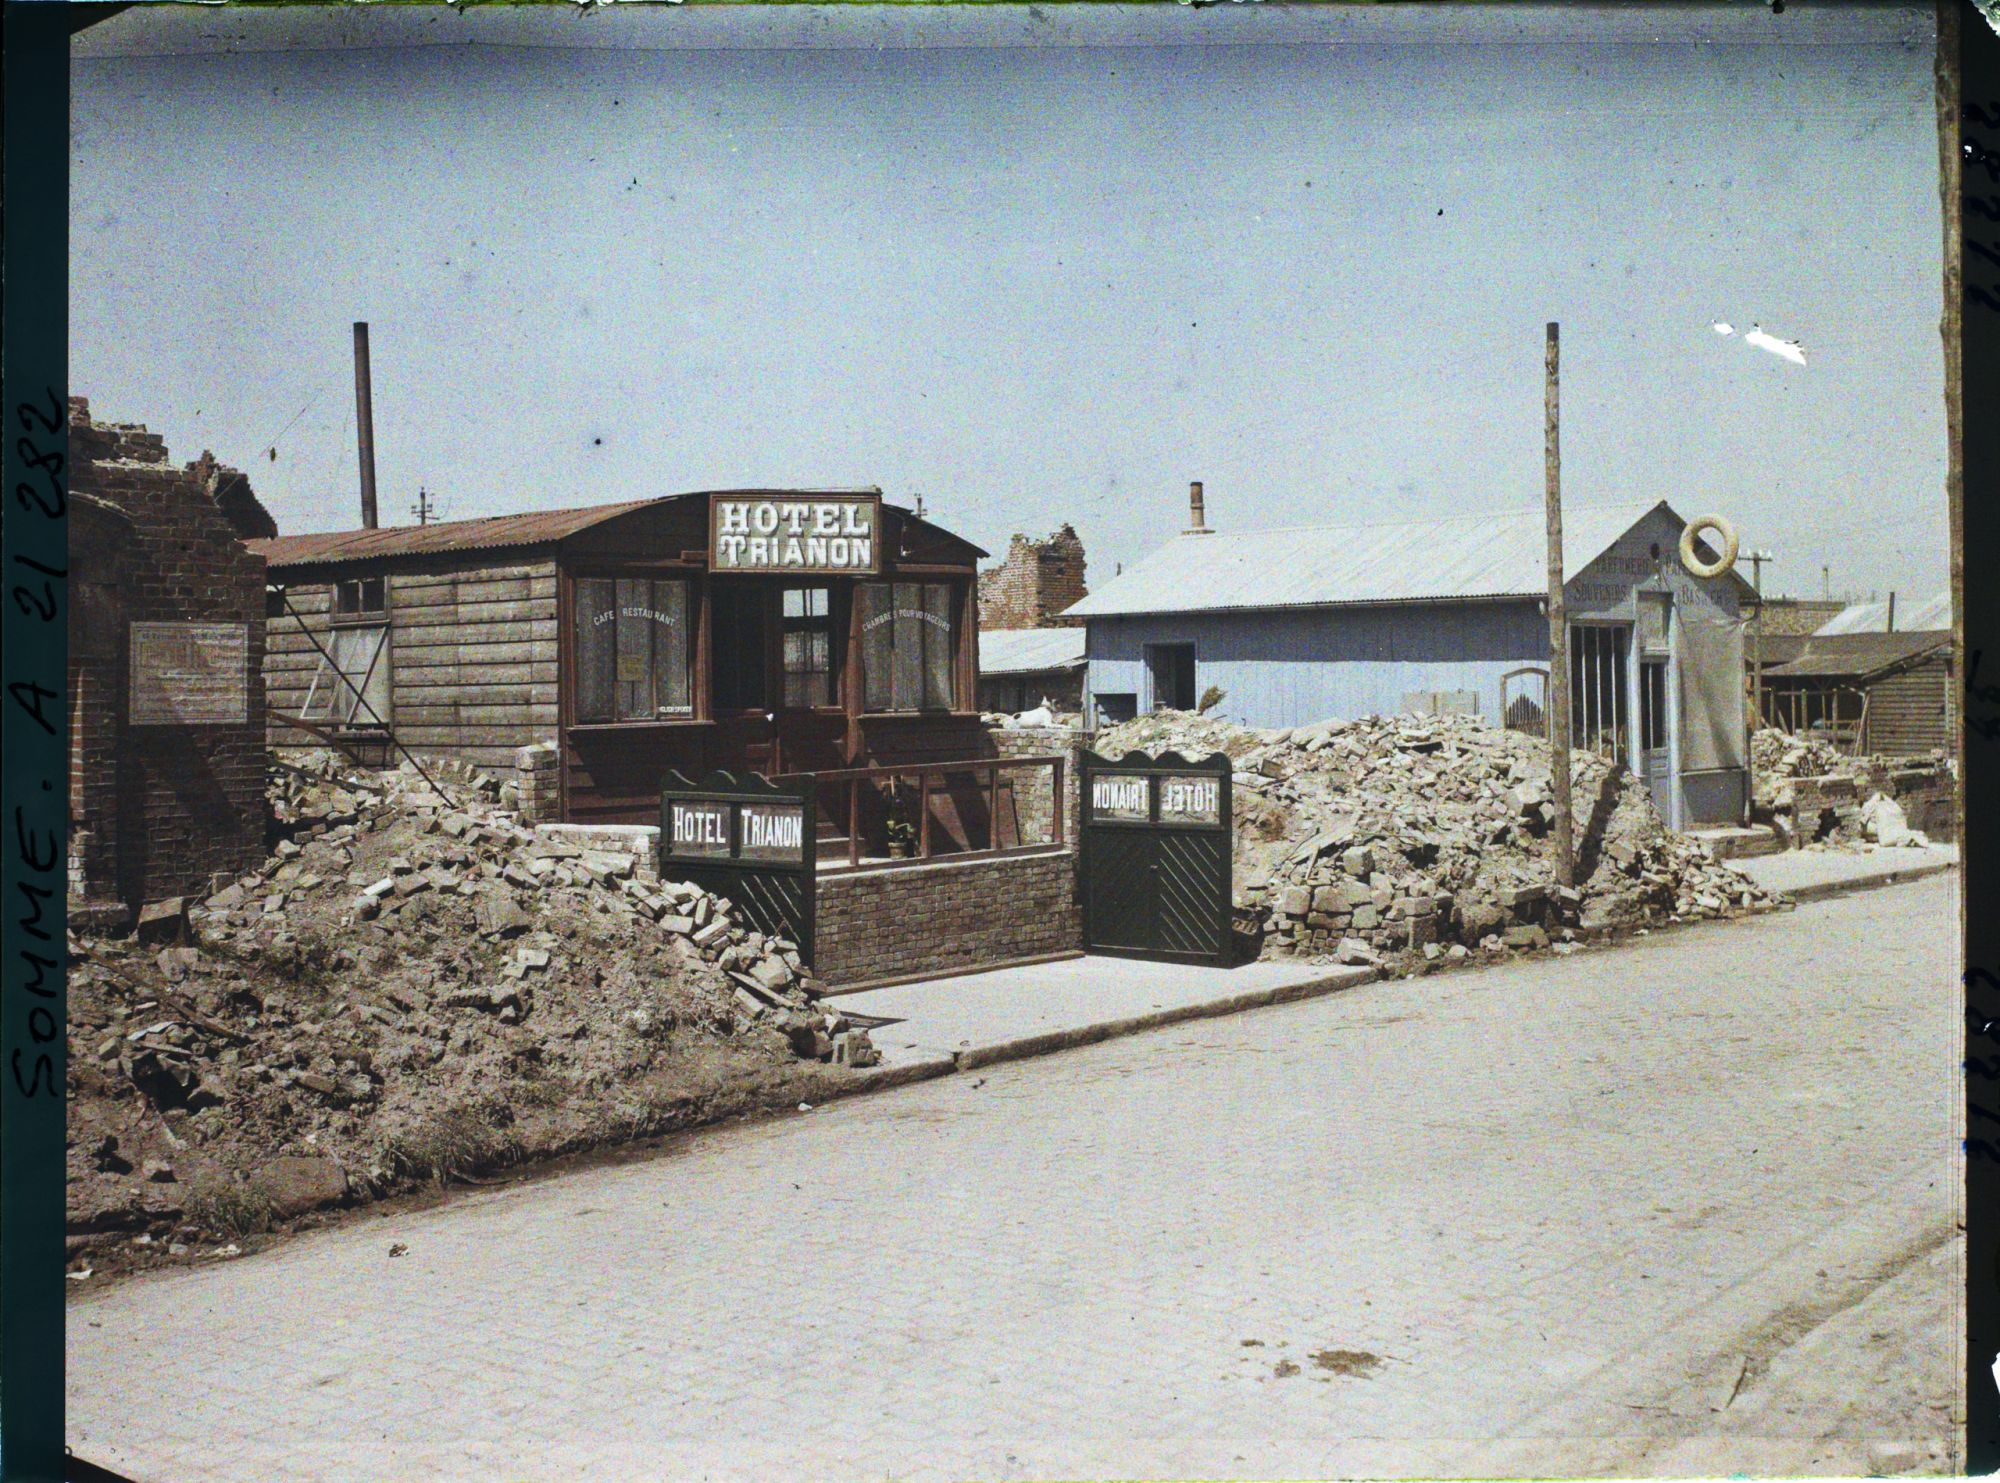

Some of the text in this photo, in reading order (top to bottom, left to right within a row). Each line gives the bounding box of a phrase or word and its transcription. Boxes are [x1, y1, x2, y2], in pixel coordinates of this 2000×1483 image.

[15, 382, 66, 520] 282
[721, 502, 870, 536] HOTEL
[719, 535, 871, 567] TRIANON
[12, 555, 67, 624] 21
[622, 607, 676, 627] RESTAURANT
[8, 680, 59, 735] A
[673, 806, 803, 848] HOTEL TRIANON
